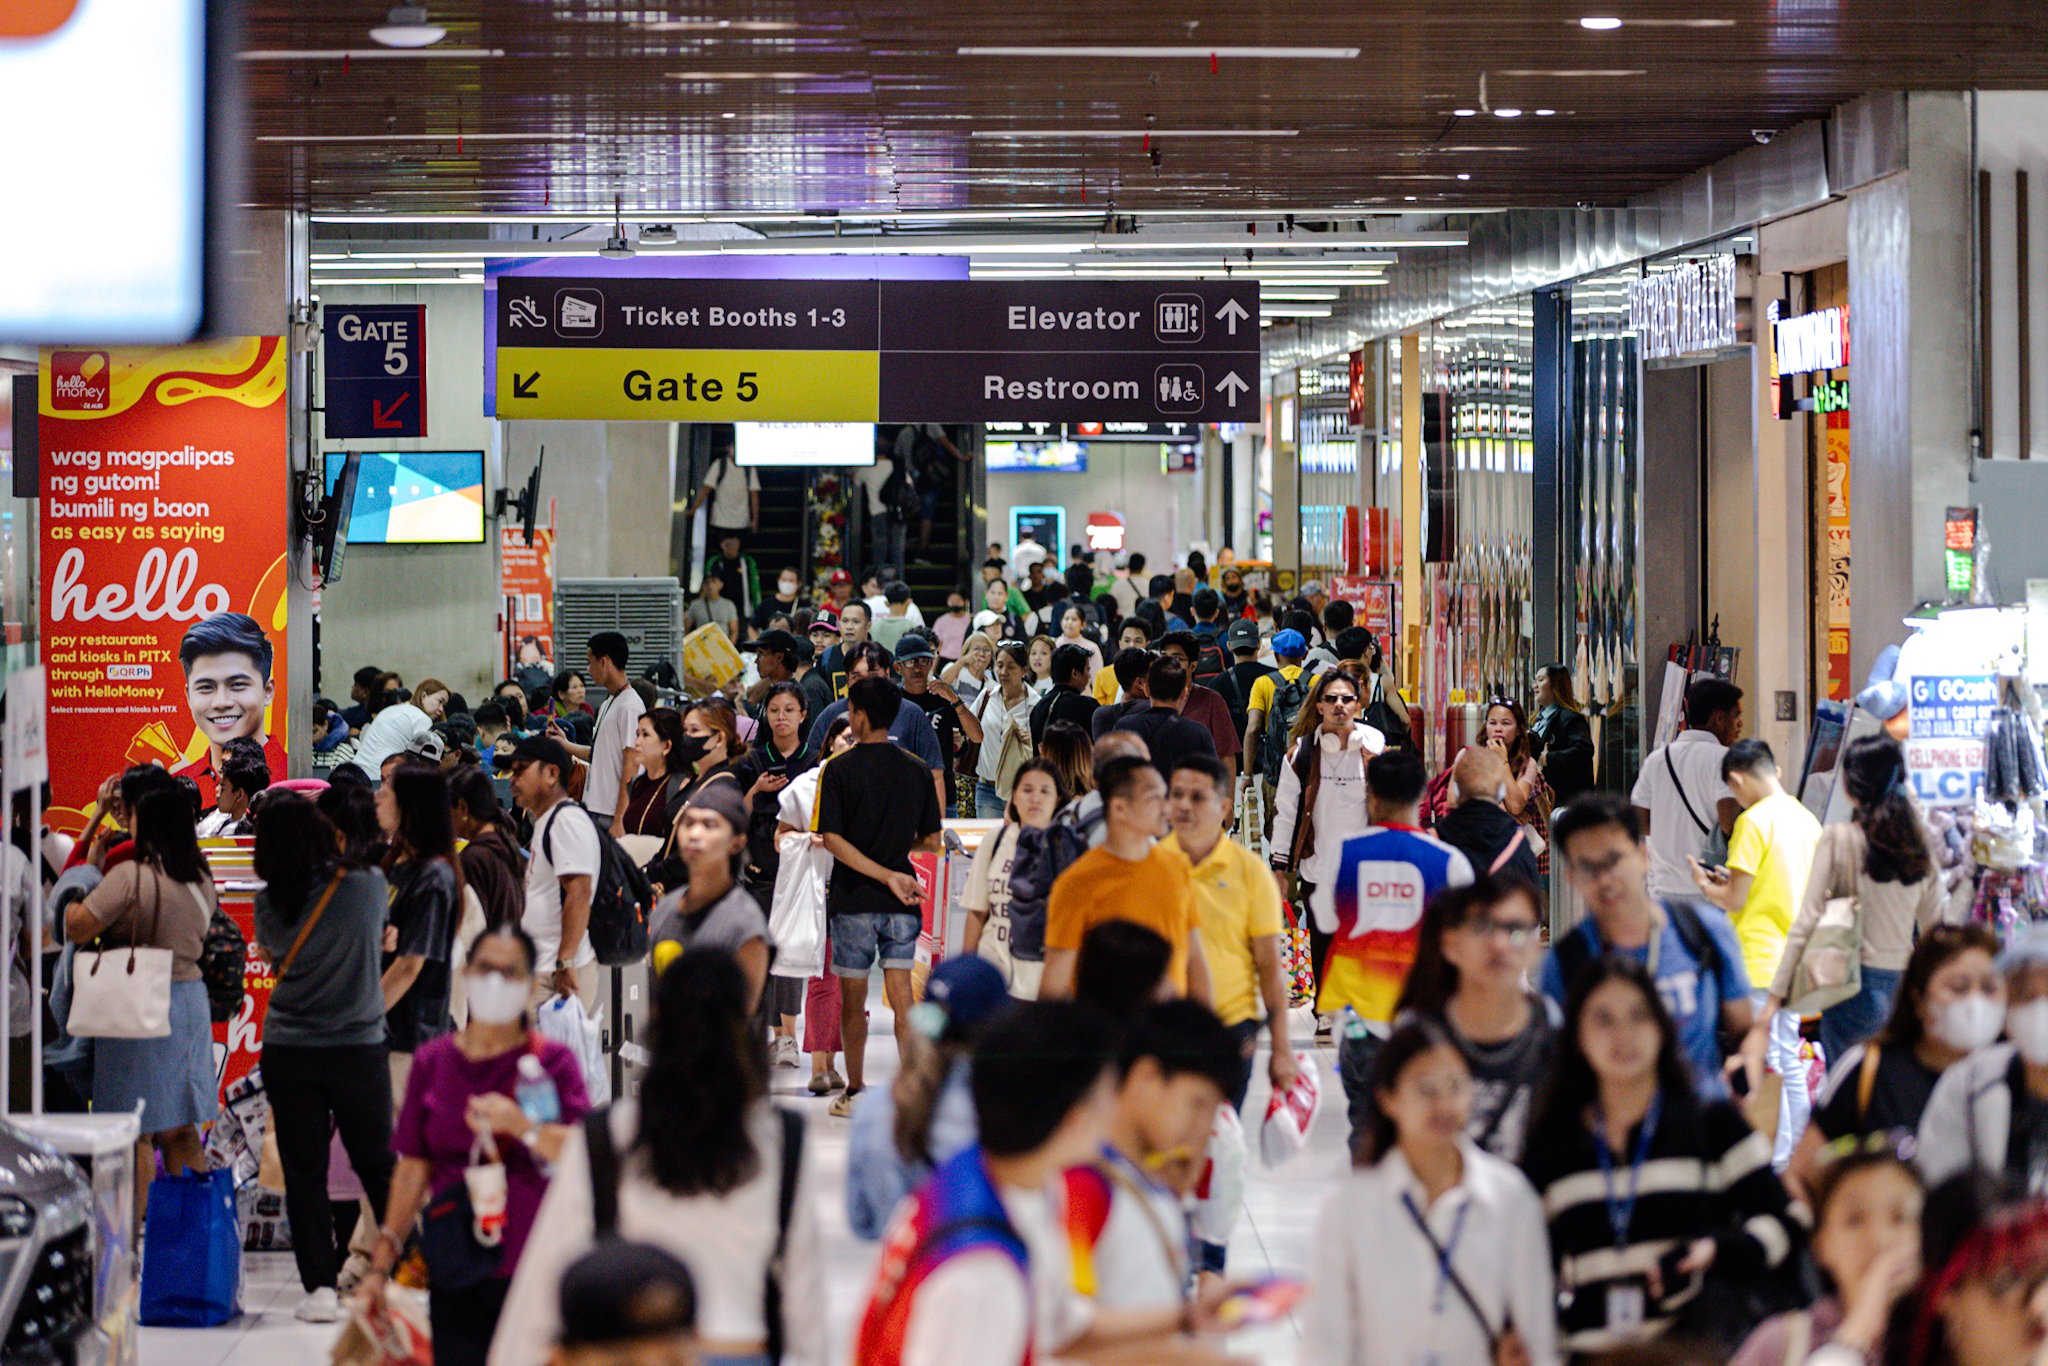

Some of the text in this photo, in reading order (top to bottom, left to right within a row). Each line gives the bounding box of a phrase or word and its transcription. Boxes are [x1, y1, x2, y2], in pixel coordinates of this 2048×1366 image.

[621, 306, 846, 327] Ticket Booths 1-3
[1008, 306, 1140, 330] Elevator
[338, 314, 408, 342] GATE
[384, 342, 408, 375] 5
[57, 375, 86, 388] hello
[623, 370, 758, 402] Gate 5
[984, 375, 1139, 400] Restroom
[56, 387, 105, 402] money
[51, 445, 234, 470] wag magpalipas
[51, 471, 160, 495] ng gutom!
[51, 497, 209, 522] bumili ng baon
[51, 522, 225, 543] as easy as saying
[51, 547, 230, 622] hello
[51, 635, 158, 648] pay restaurants
[51, 650, 171, 662] and kiosks in PITX
[51, 668, 104, 683] through
[51, 686, 164, 699] with HelloMoney
[1938, 677, 1997, 702] GCash
[51, 705, 73, 713] Select
[129, 705, 151, 713] kiosks
[151, 705, 159, 713] in
[160, 705, 177, 713] PITX
[1367, 882, 1415, 898] DITO
